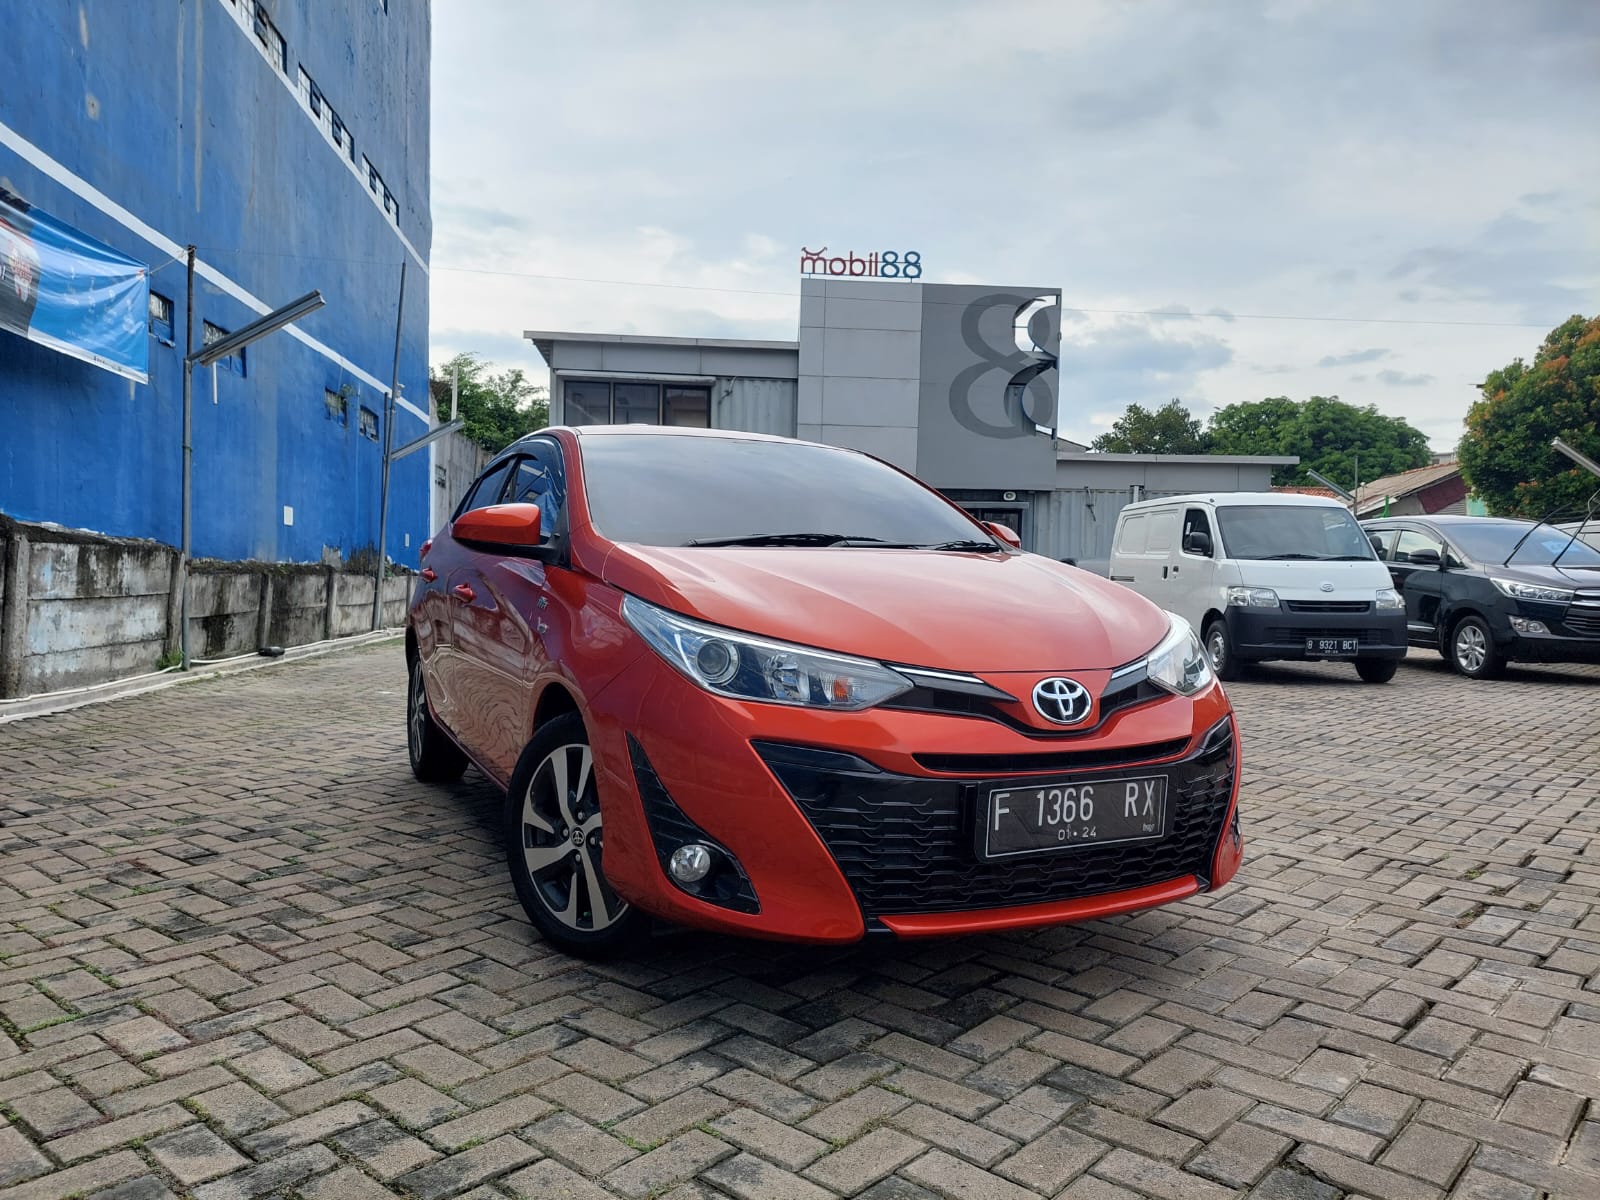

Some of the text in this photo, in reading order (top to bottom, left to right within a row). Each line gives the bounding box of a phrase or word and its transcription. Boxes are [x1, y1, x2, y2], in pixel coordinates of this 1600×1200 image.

[801, 248, 922, 279] mobil88
[1319, 639, 1337, 650] 9321
[1342, 640, 1357, 650] BCT
[994, 780, 1155, 831] F 1366 RX
